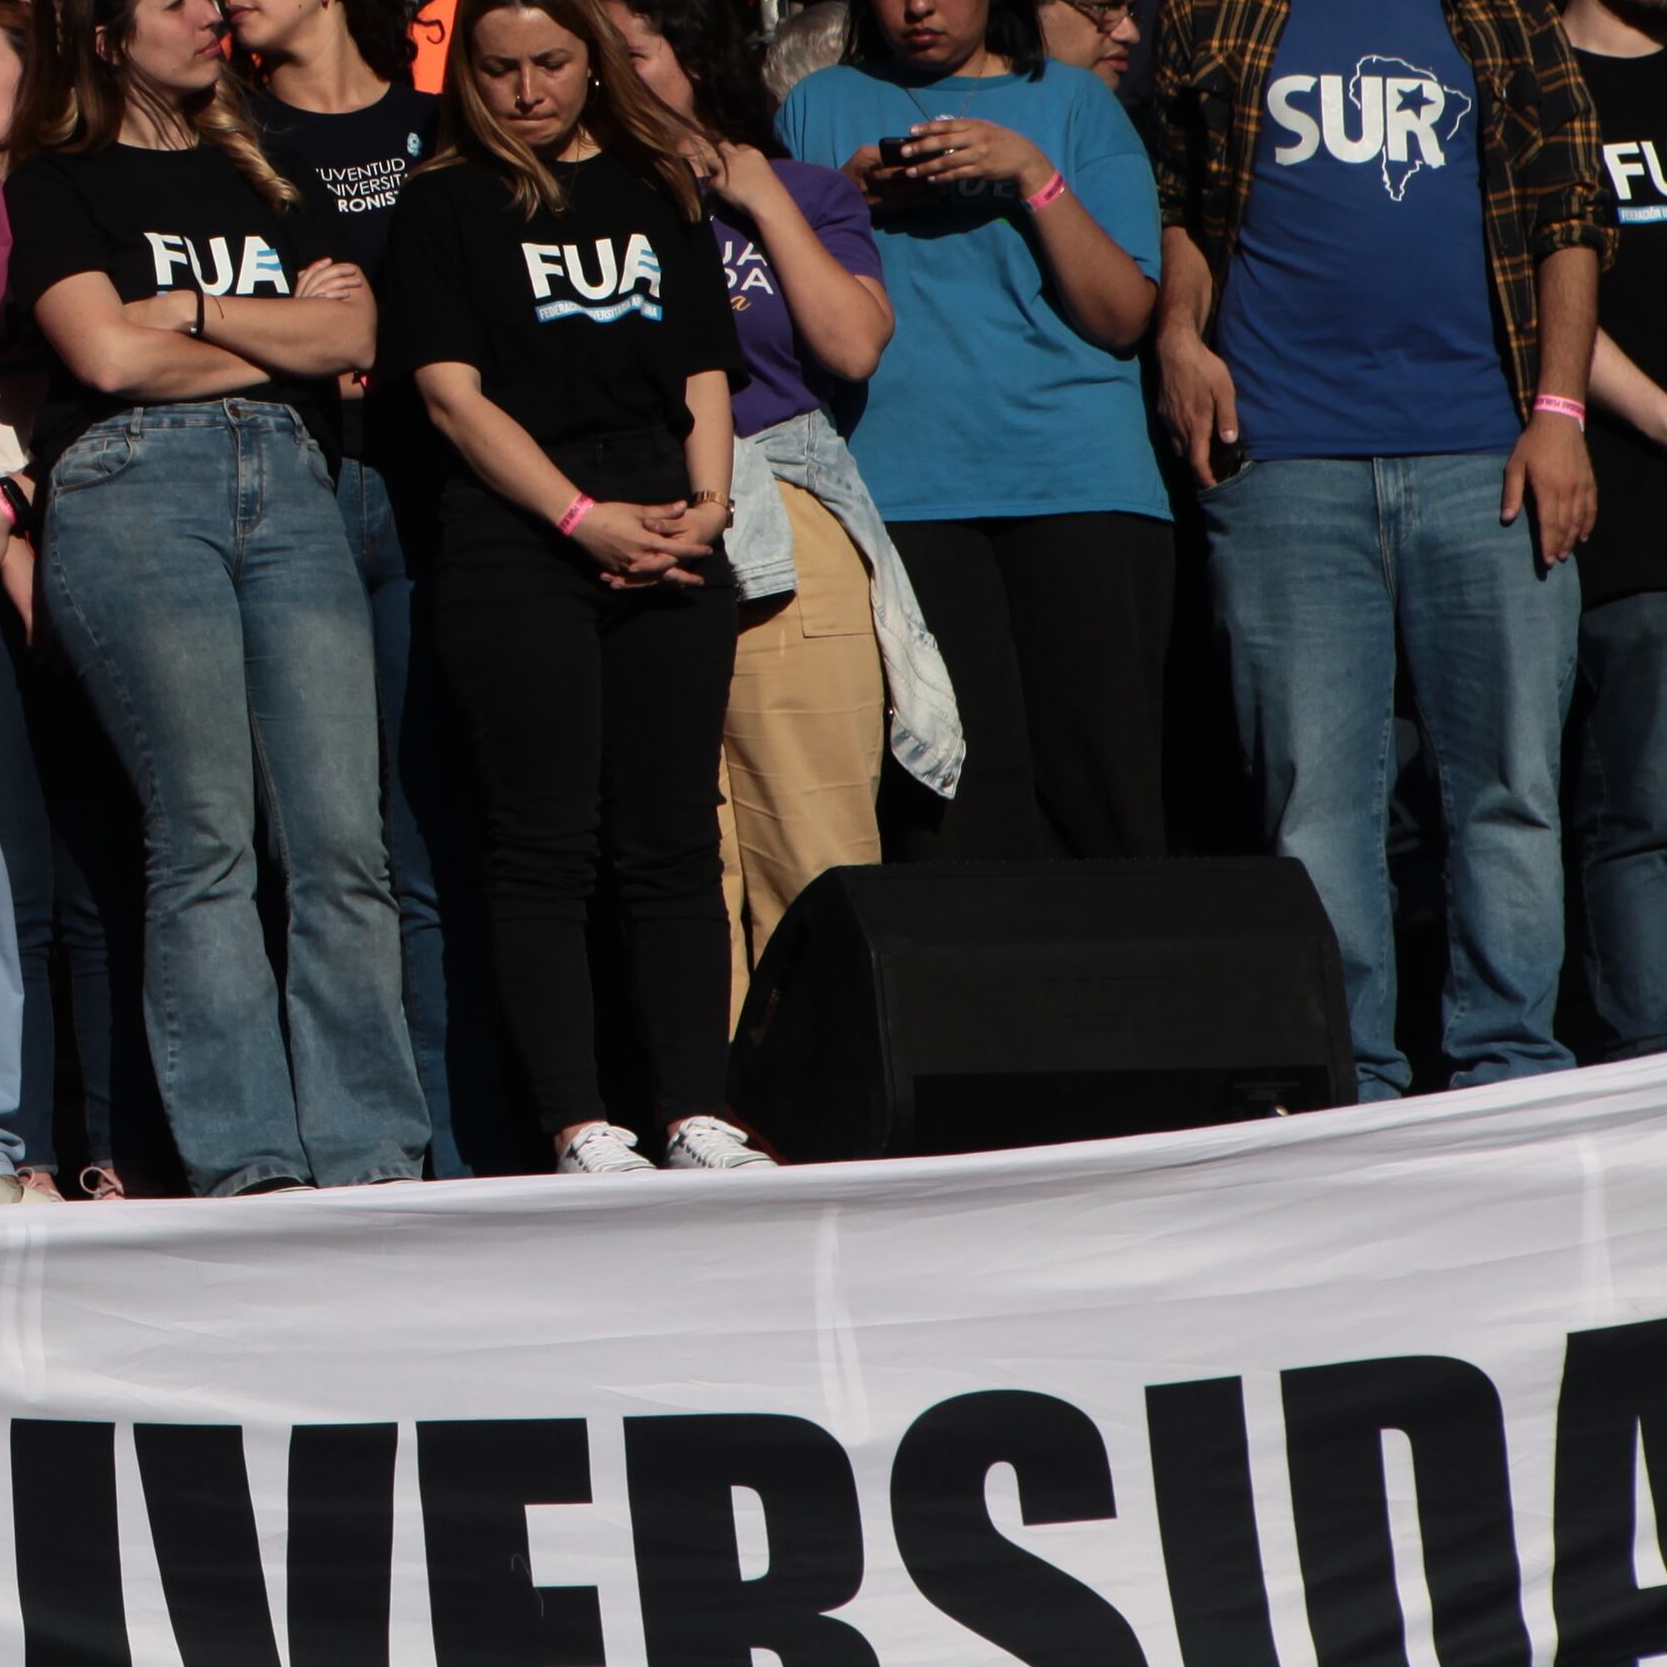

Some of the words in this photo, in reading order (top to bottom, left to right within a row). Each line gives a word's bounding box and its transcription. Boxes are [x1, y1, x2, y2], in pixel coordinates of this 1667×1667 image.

[1267, 74, 1446, 169] SUR
[316, 158, 406, 182] UVENTUD
[338, 190, 399, 212] RONIS
[143, 232, 290, 296] FUA
[521, 234, 662, 300] FUA
